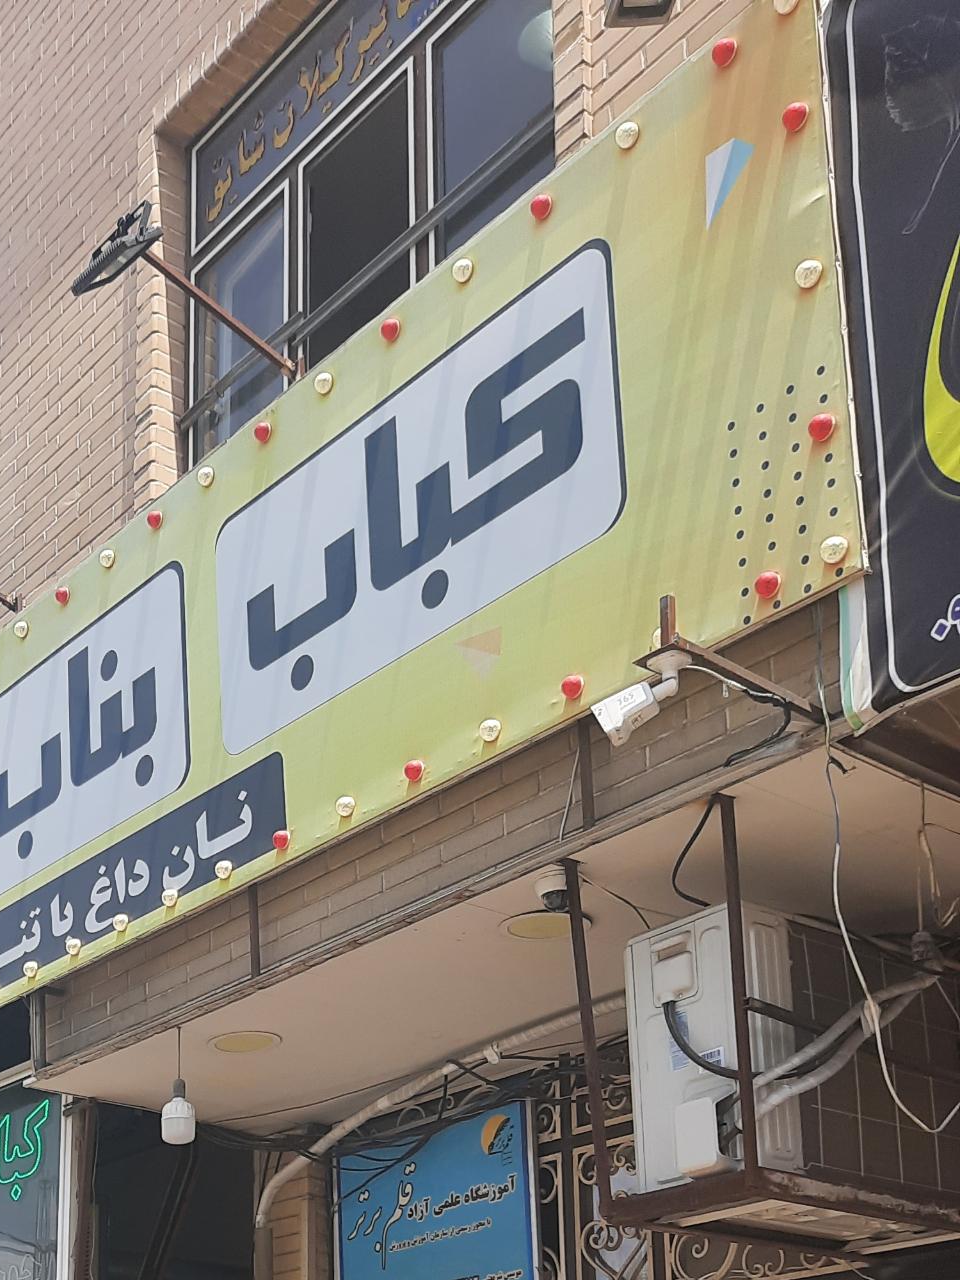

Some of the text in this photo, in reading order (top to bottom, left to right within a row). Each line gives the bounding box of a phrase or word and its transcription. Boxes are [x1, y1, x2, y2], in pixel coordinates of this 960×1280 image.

[247, 307, 586, 691] کباب
[162, 790, 253, 892] نان
[49, 893, 74, 943] با
[84, 857, 150, 934] داغ
[381, 1161, 417, 1271] قلم
[407, 1174, 517, 1222] آموزشگاه علمی آزاد
